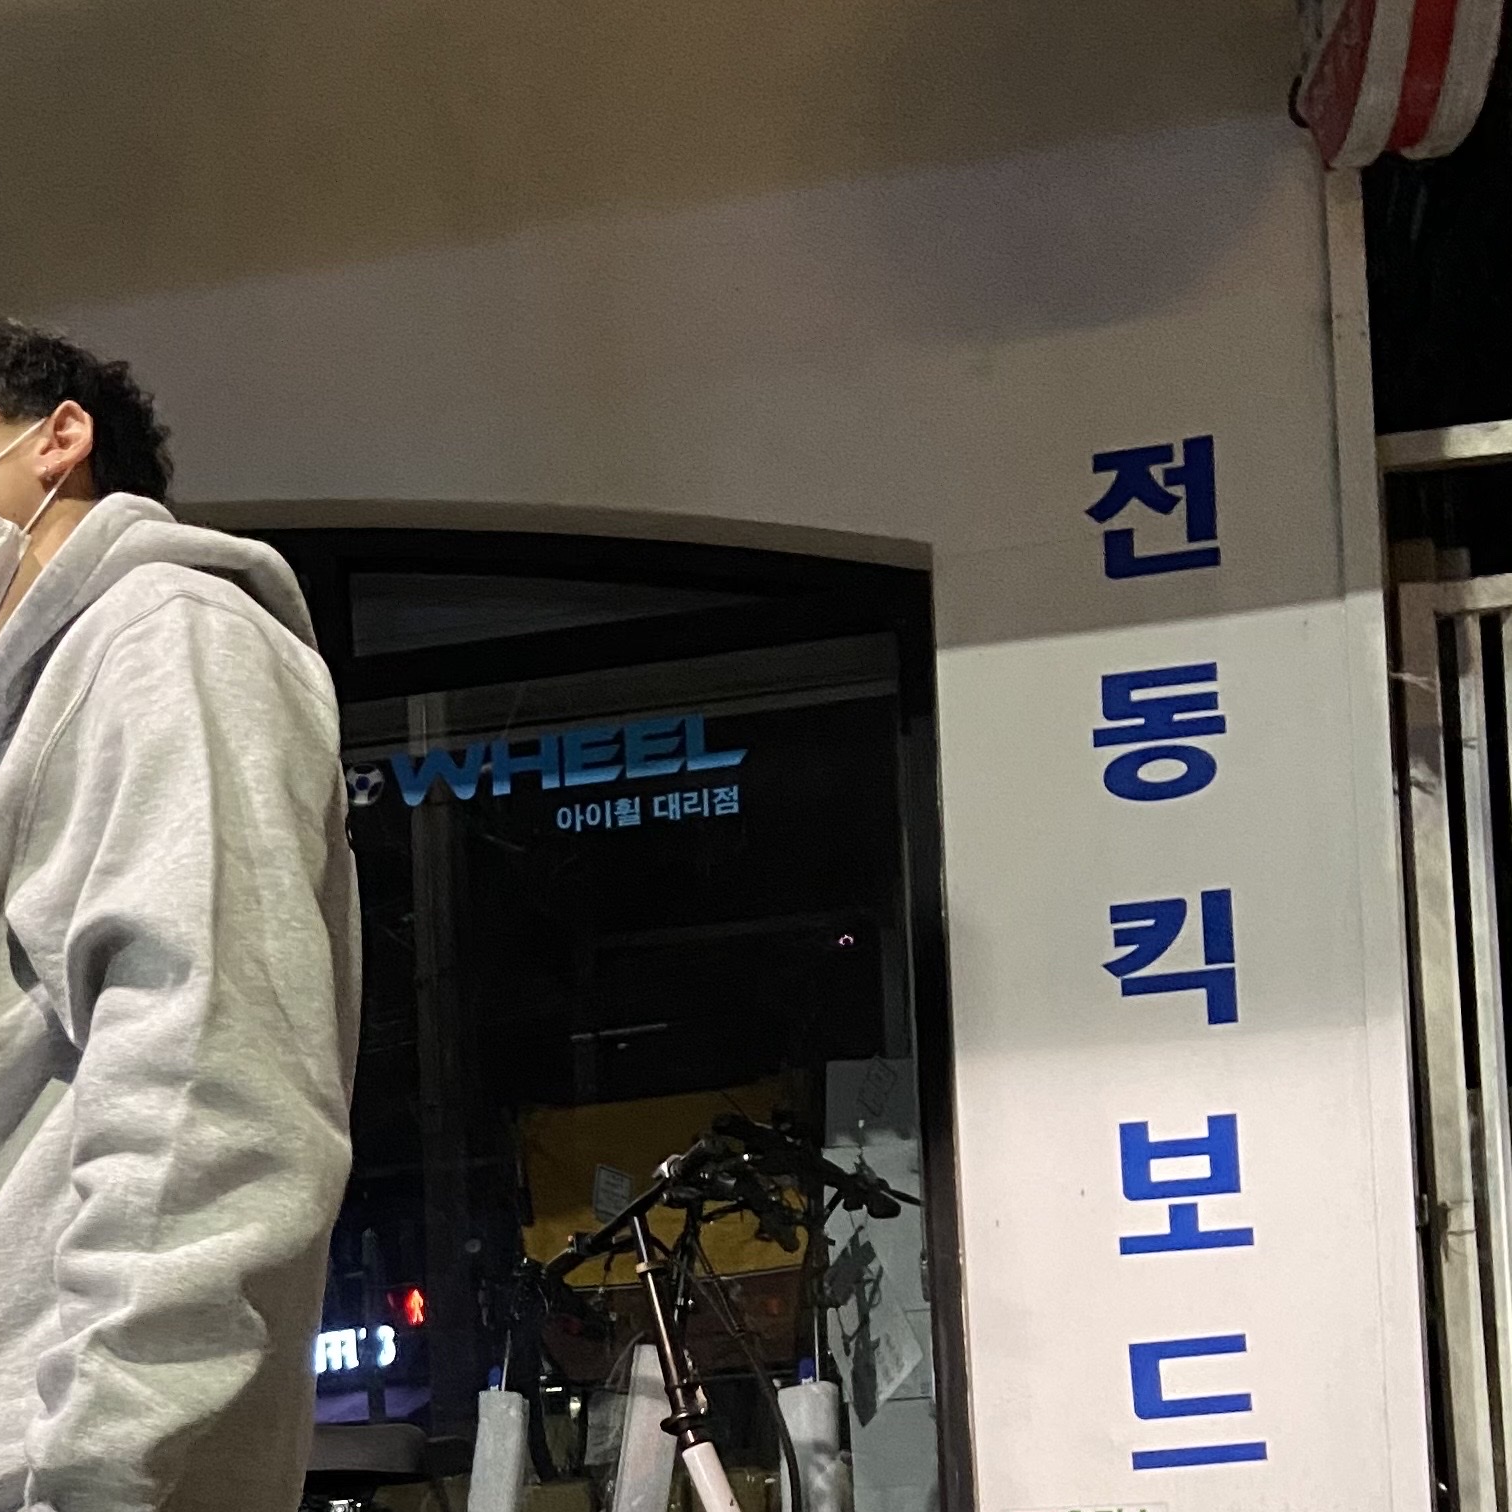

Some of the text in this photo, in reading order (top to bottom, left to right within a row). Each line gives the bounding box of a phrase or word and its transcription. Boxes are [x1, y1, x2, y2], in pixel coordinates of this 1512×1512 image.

[391, 712, 749, 807] WHEEL
[556, 784, 741, 833] 아이휠 대리점
[1084, 435, 1268, 1472] 전동킥보드
